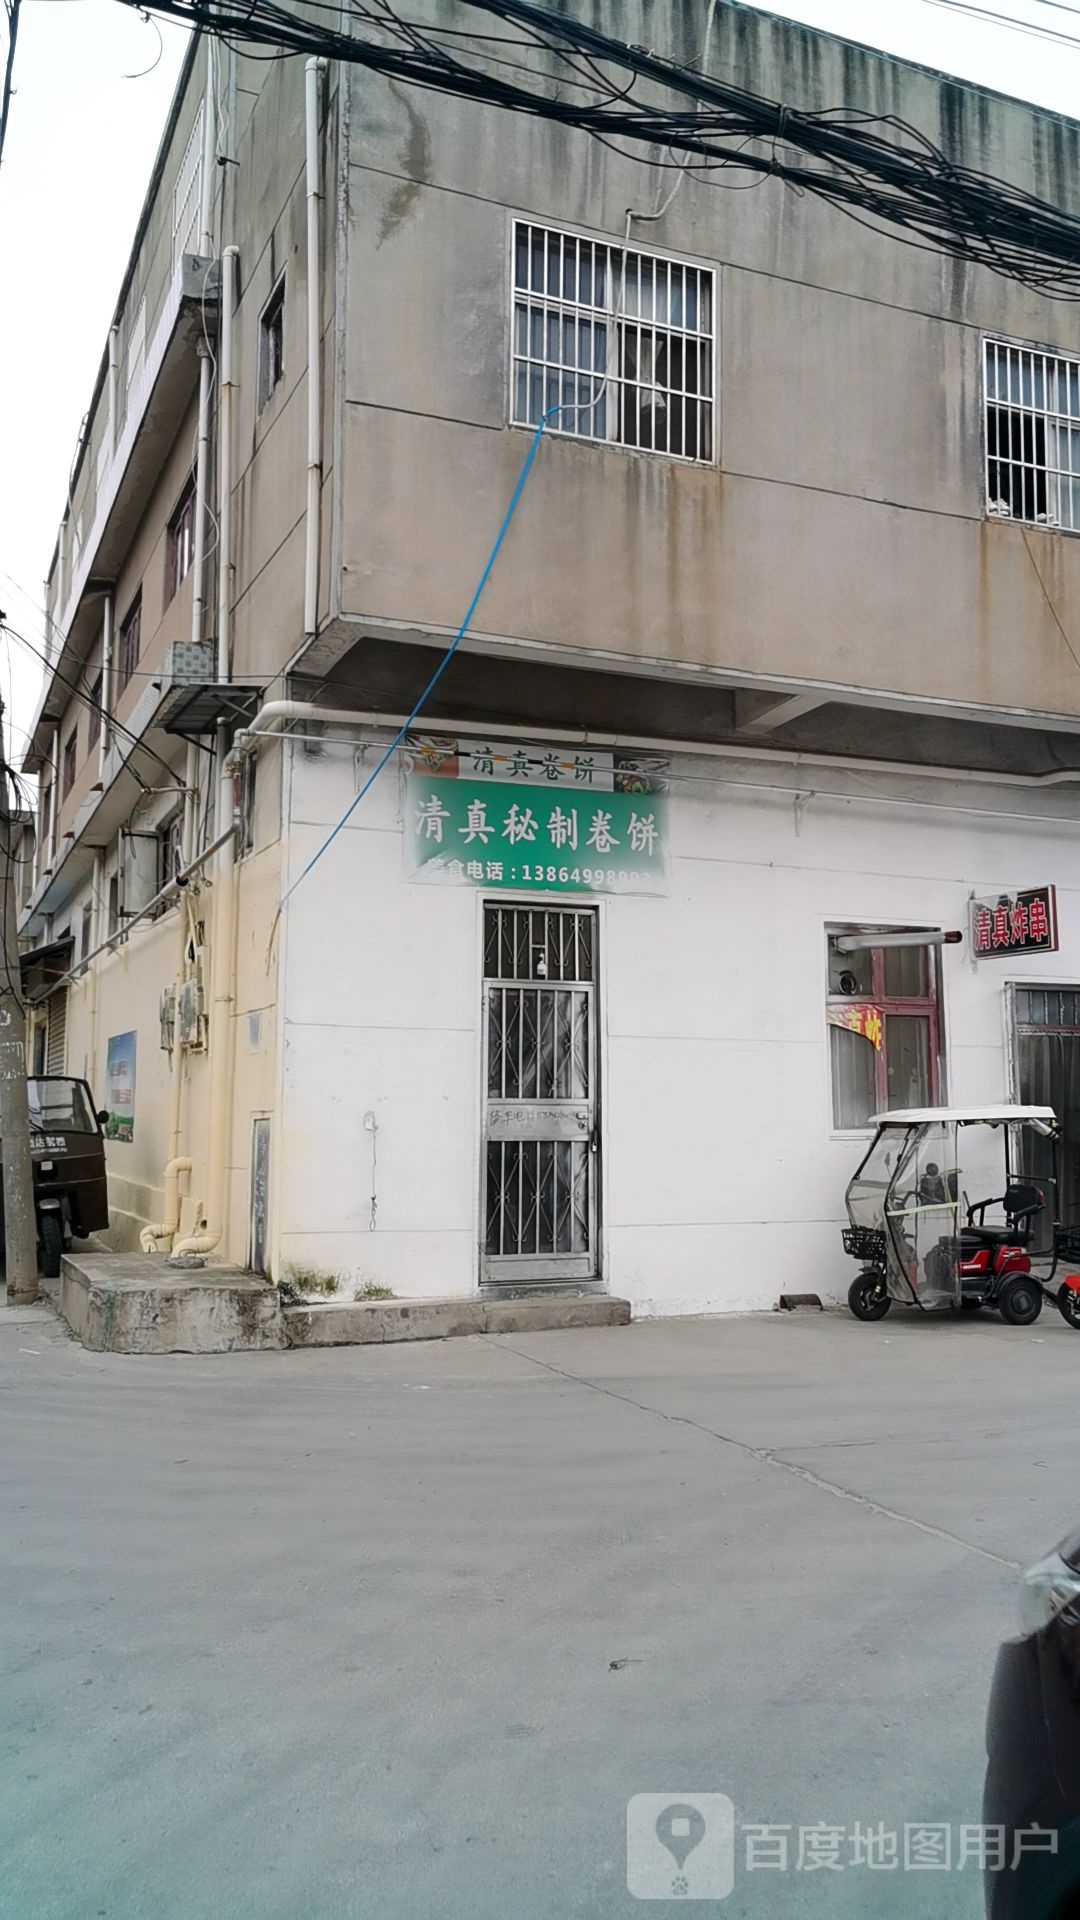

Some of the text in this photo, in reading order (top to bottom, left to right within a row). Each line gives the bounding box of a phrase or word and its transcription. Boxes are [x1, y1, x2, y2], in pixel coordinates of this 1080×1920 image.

[472, 746, 597, 784] 清真卷饼
[414, 794, 660, 857] 清真秘制卷饼
[974, 898, 1049, 951] 清真炸串
